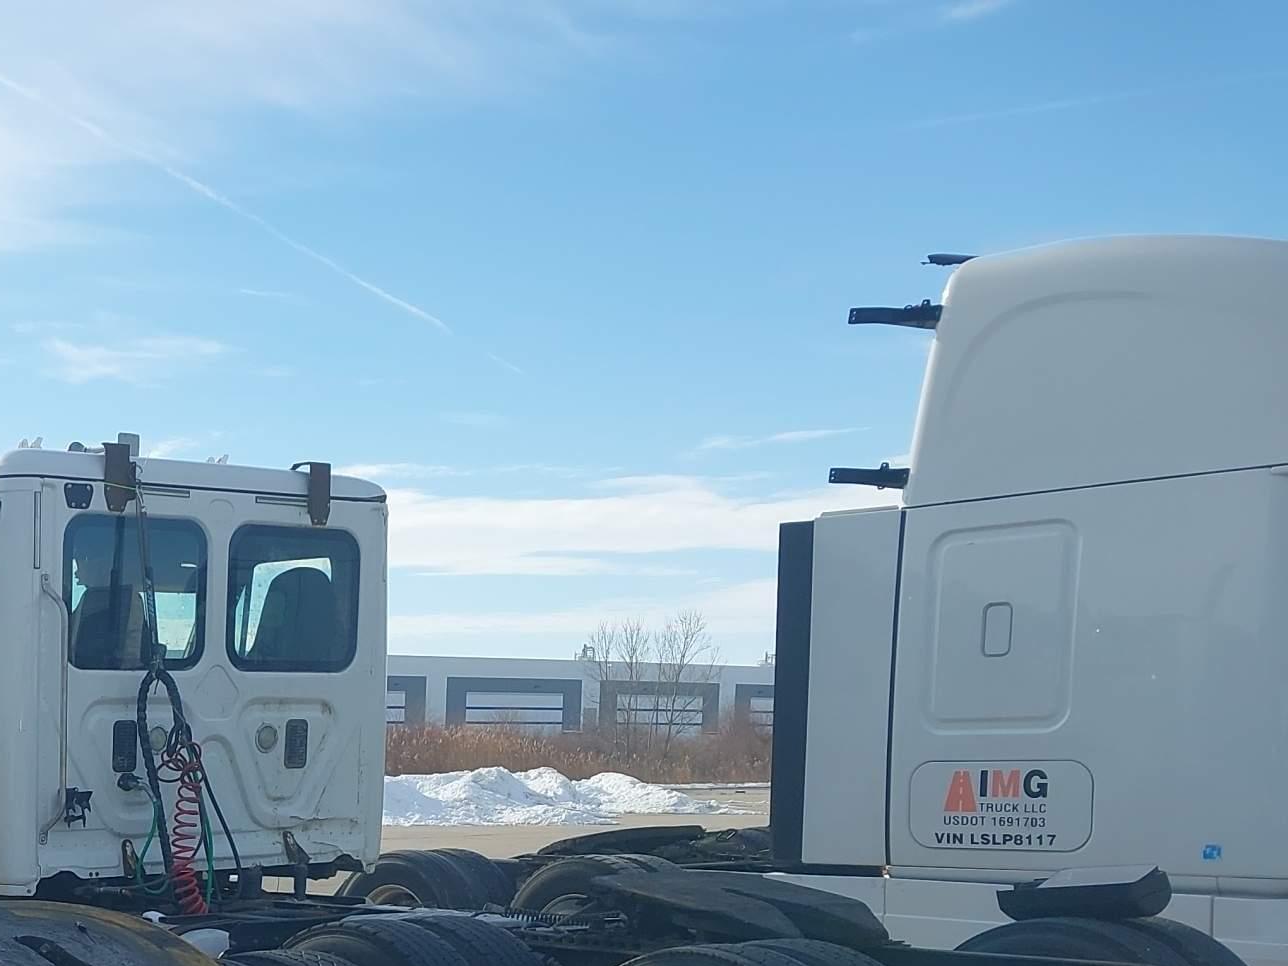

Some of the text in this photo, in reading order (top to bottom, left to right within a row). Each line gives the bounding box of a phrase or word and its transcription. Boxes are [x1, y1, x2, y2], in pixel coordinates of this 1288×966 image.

[978, 802, 1047, 813] TRUCK LLC
[943, 815, 1046, 828] USDOT 1691703
[934, 832, 1057, 846] VIN LSLP8117
